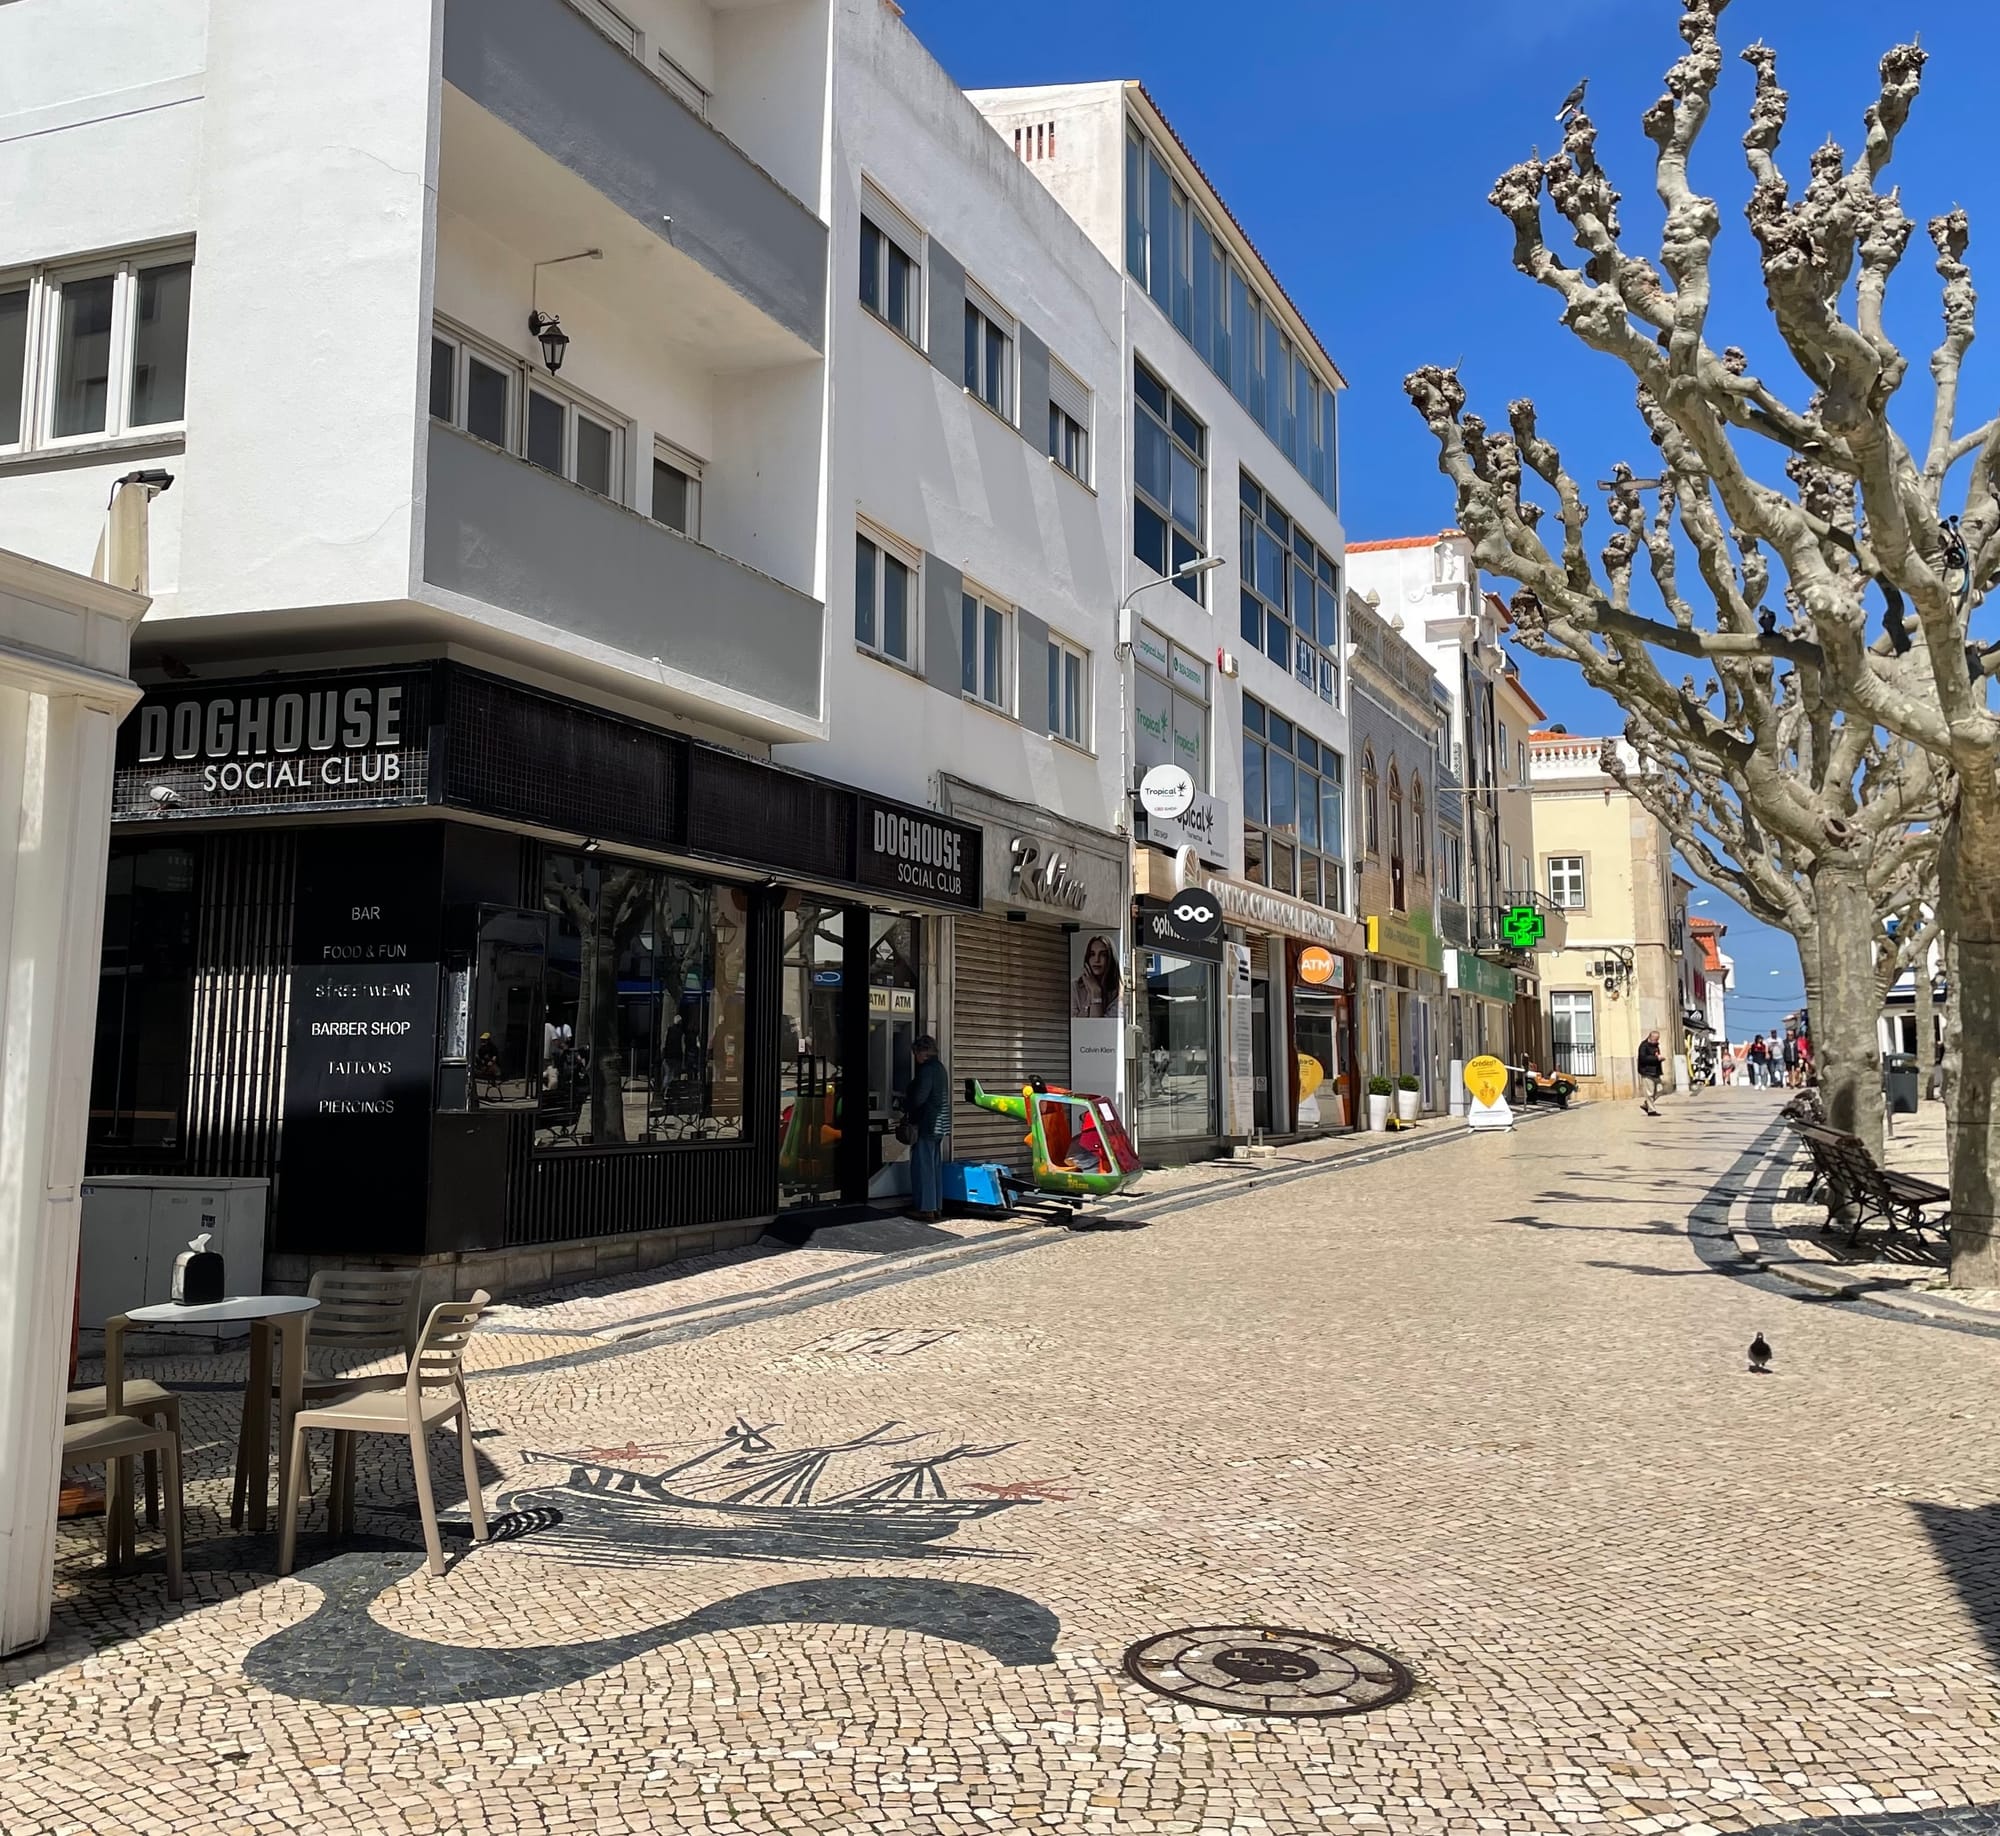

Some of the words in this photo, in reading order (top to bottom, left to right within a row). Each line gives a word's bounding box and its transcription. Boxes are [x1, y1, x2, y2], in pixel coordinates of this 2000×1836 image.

[138, 686, 402, 762] DOGHOUSE
[1136, 707, 1161, 734] Tropical
[1174, 729, 1196, 753] Tropical
[203, 758, 311, 793] SOCIAL
[321, 754, 401, 785] CLUB
[1145, 787, 1177, 796] Tropical
[874, 810, 961, 872] DOGHOUSE
[898, 863, 935, 890] SOCIAL
[937, 872, 962, 895] CLUB
[351, 906, 381, 921] BAR
[323, 944, 362, 959] FOOD
[366, 944, 375, 958] &
[379, 943, 407, 958] FUN
[1301, 959, 1330, 971] ATM
[870, 993, 886, 1007] ATM
[895, 995, 911, 1008] ATM
[312, 1021, 367, 1036] BARBER
[371, 1020, 411, 1036] SHOP
[329, 1061, 393, 1075] TATTOOS
[319, 1099, 394, 1115] PIERCINGS
